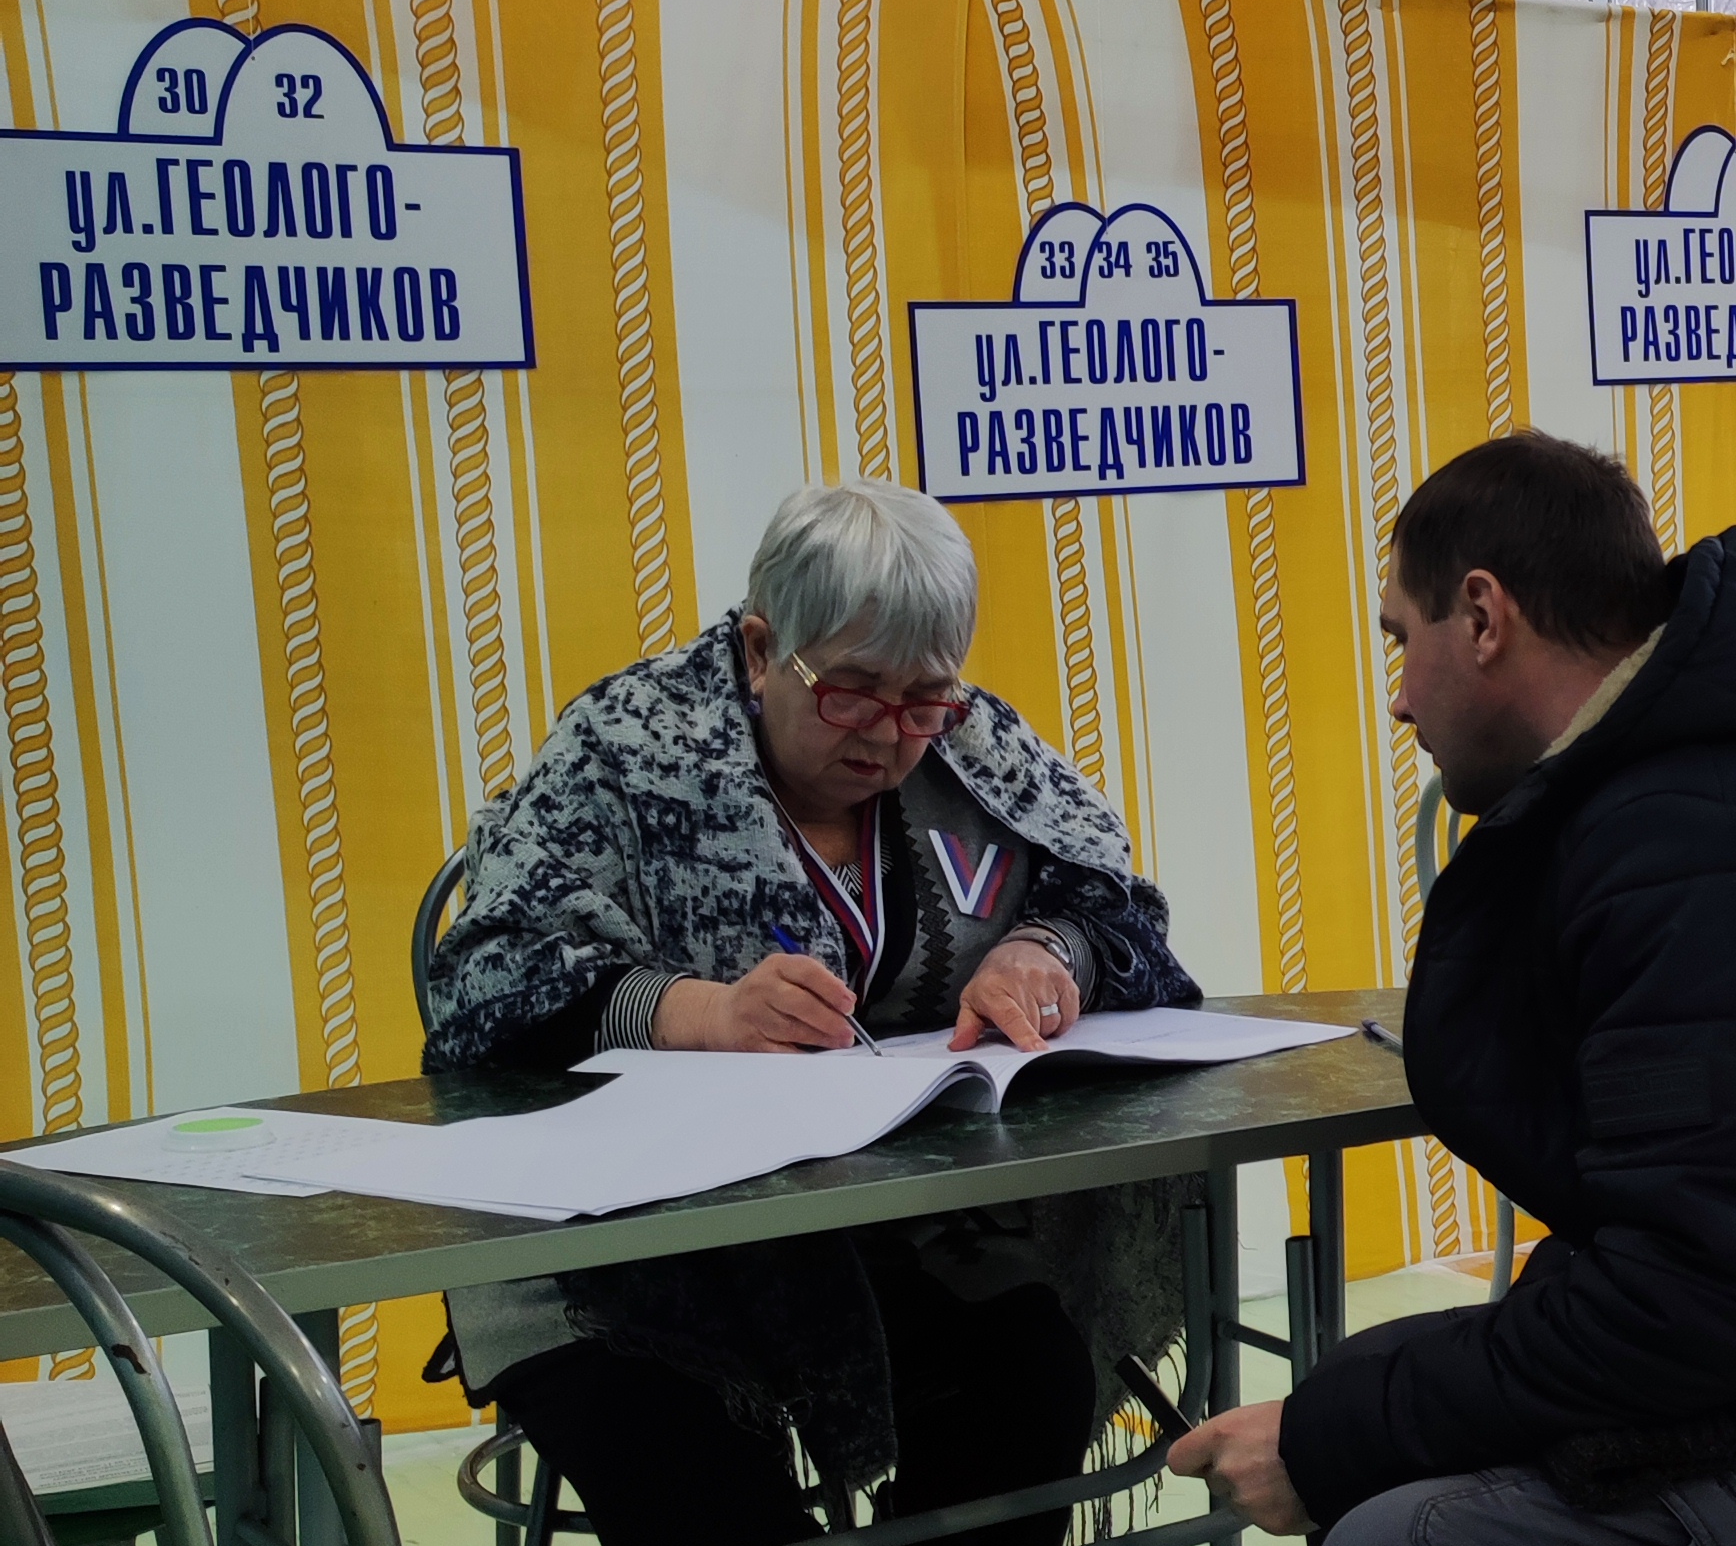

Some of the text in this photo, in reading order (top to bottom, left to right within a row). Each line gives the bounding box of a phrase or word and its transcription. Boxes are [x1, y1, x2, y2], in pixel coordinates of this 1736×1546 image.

[155, 66, 325, 120] 30 32
[64, 157, 422, 253] ул.ГЕОЛОГО-
[1039, 240, 1180, 280] 33 34 35
[38, 261, 461, 354] РАЗВЕДЧИКОВ
[974, 317, 1225, 403] ул.ГЕОЛОГО-
[956, 402, 1253, 481] РАЗВЕДЧИКОВ
